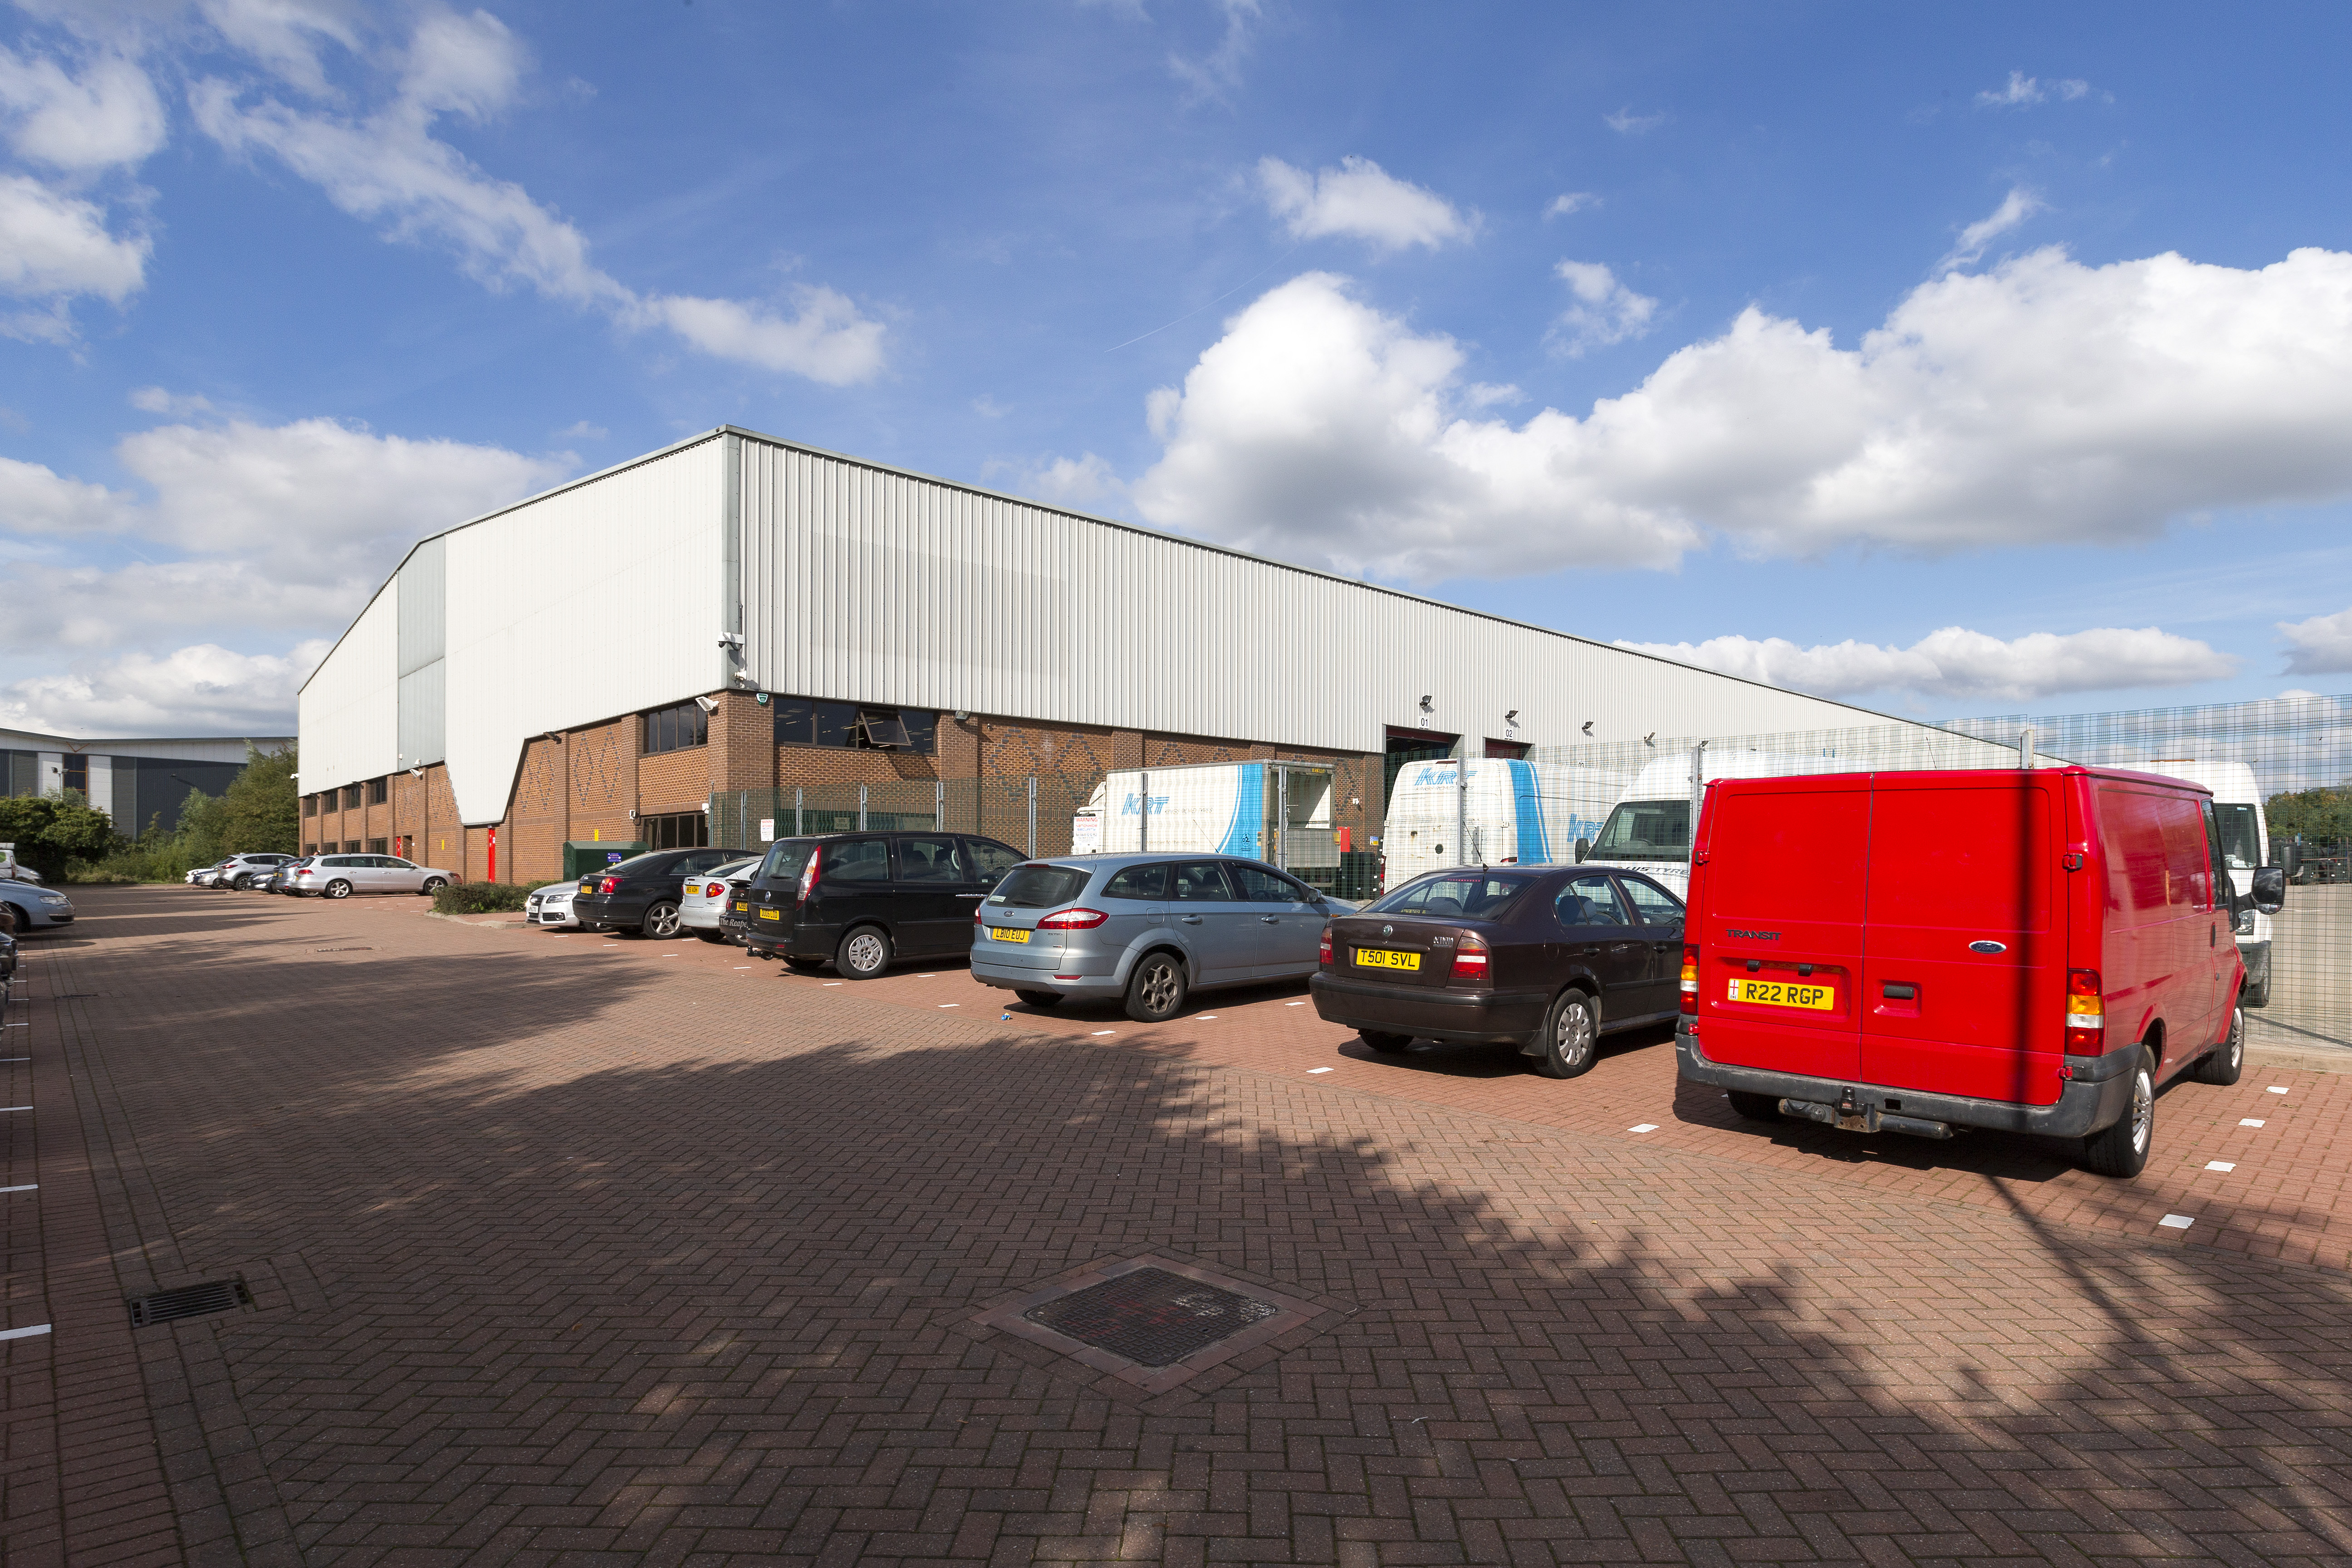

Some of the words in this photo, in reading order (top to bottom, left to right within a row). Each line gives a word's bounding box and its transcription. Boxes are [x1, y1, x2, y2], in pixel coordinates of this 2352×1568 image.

[1421, 718, 1428, 726] 01
[1505, 729, 1513, 738] 02
[1122, 793, 1170, 815] KRT
[720, 917, 729, 926] The
[730, 919, 747, 930] Reape
[996, 929, 1010, 939] LB10
[1726, 929, 1782, 940] TRANSIT
[1976, 943, 1997, 951] Ford
[1361, 950, 1386, 964] T501
[1391, 953, 1416, 967] SVL
[1746, 983, 1781, 1002] R22
[1787, 986, 1823, 1005] RGP
